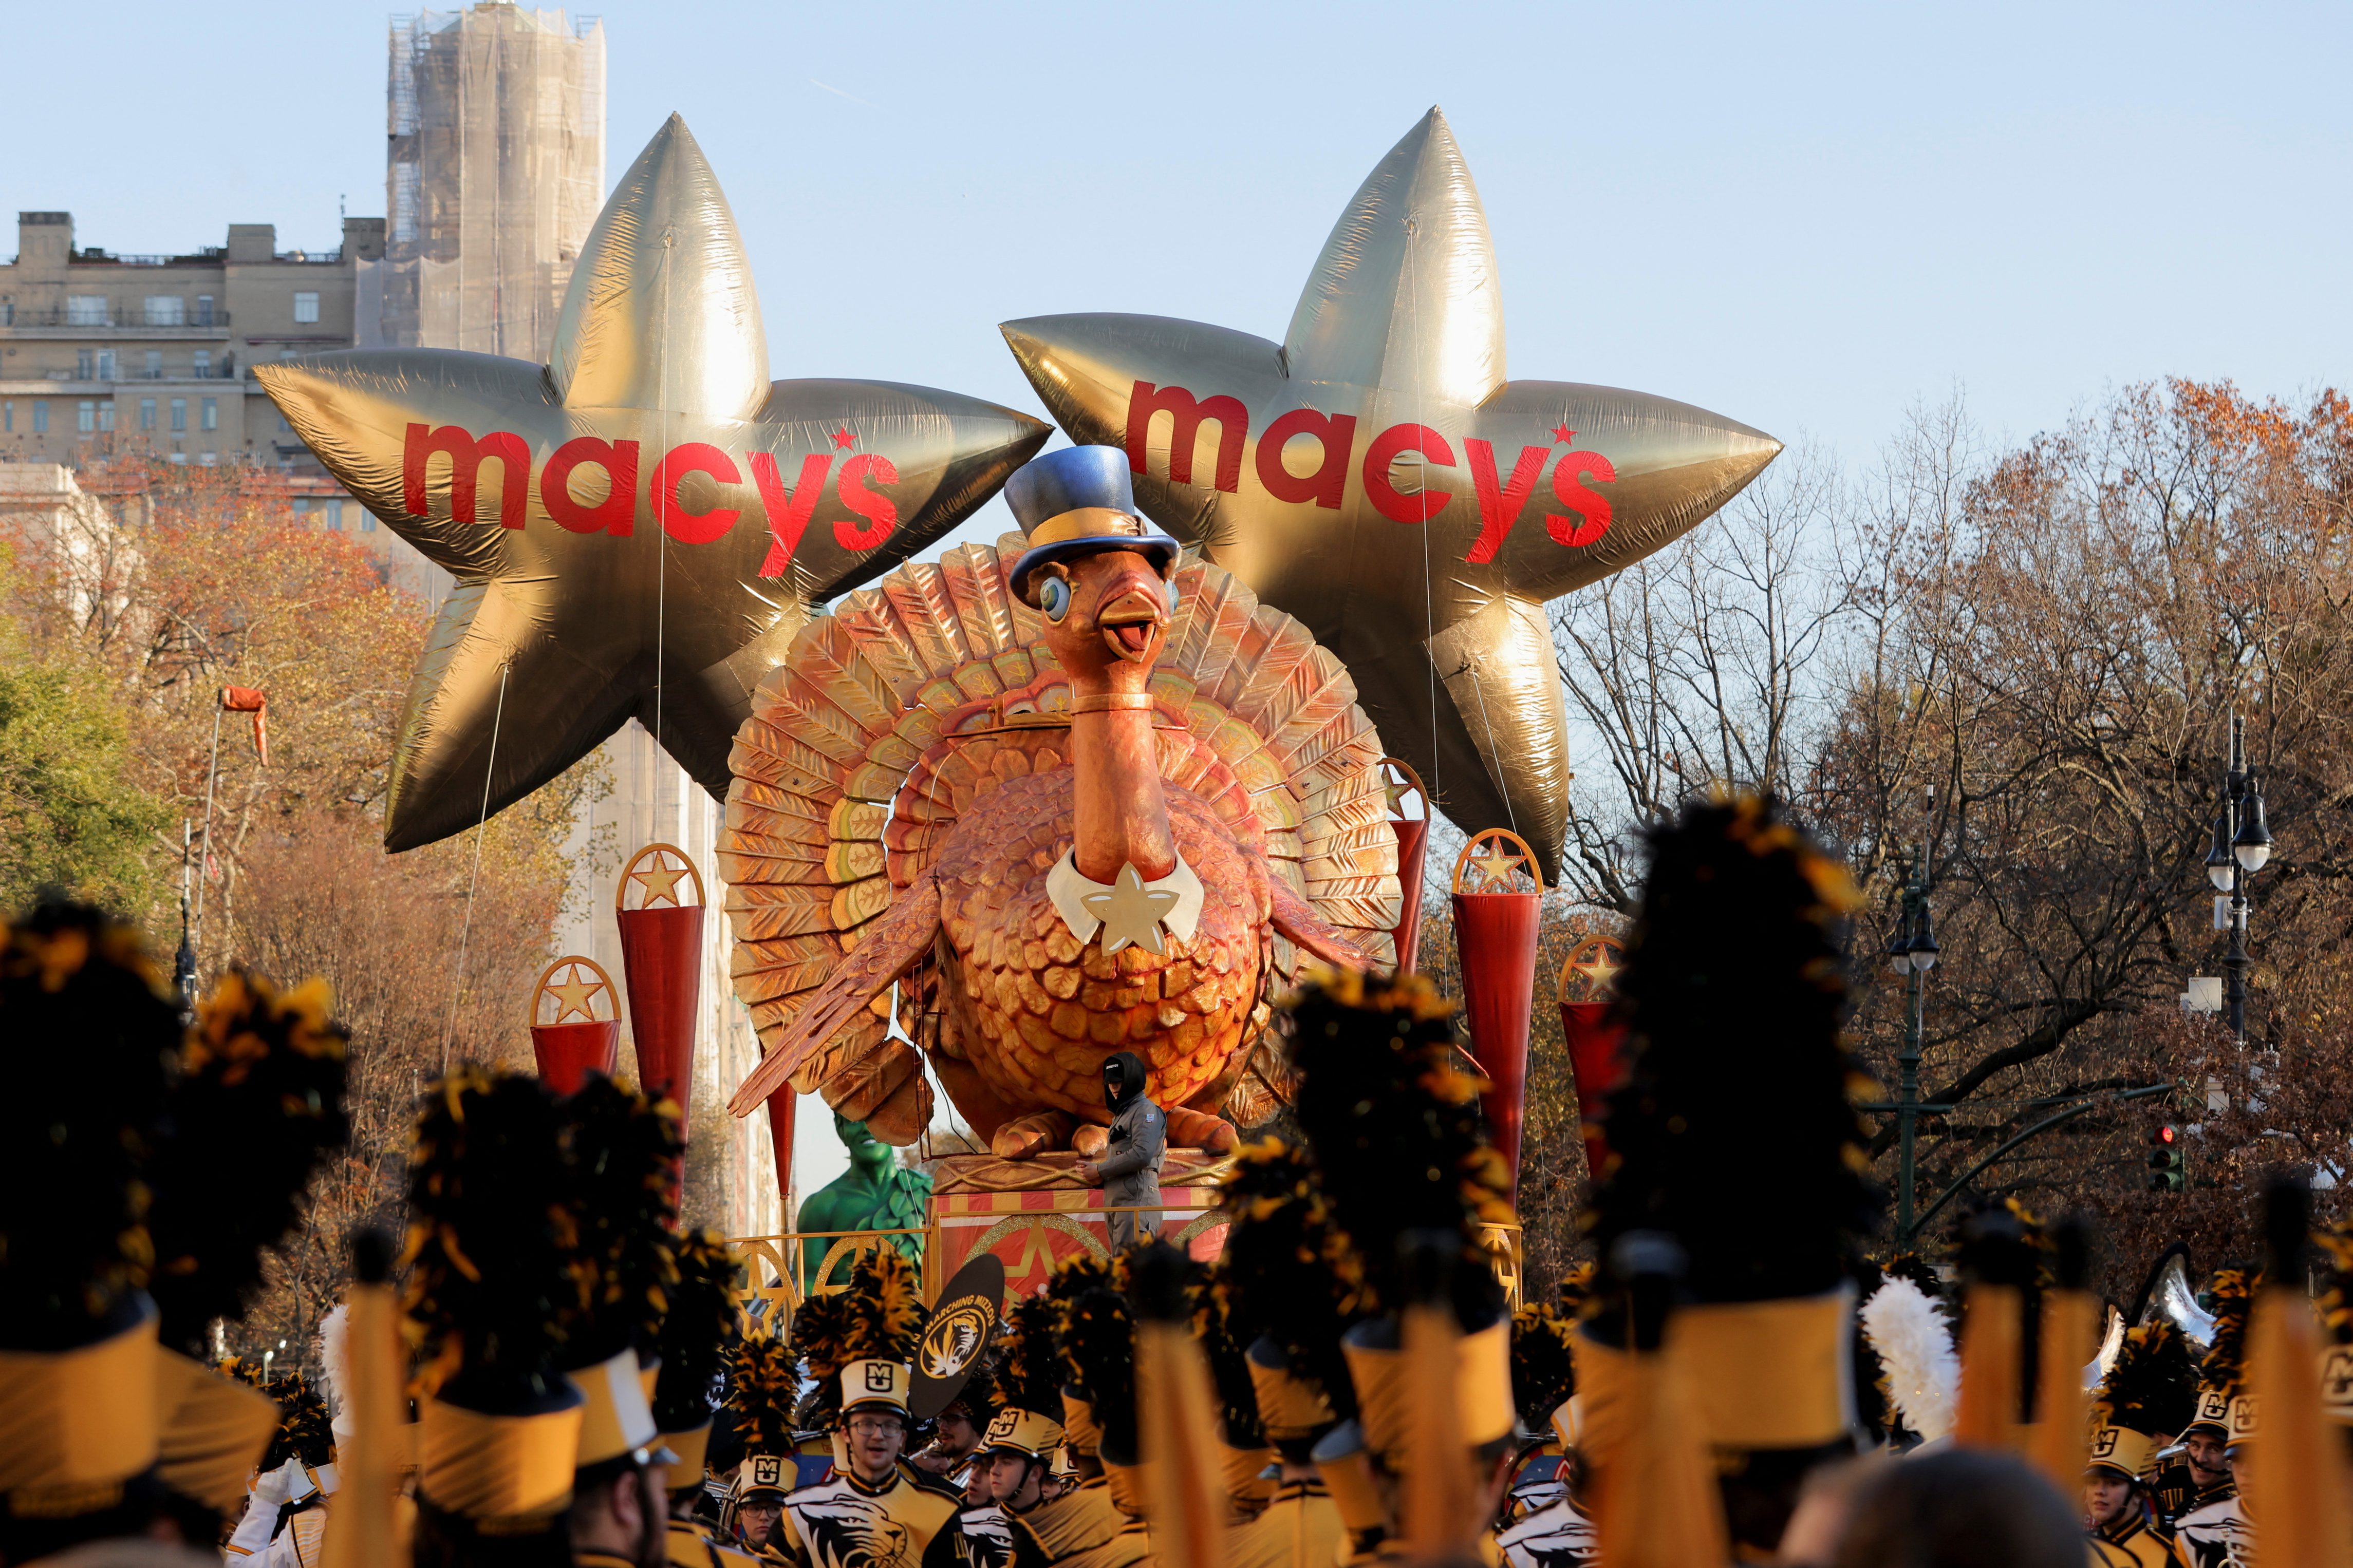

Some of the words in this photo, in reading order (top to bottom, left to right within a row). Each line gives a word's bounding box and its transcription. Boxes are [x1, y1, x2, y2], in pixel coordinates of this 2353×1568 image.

[925, 1294, 975, 1334] MARCHING
[974, 1294, 996, 1327] MIZZOU
[867, 1364, 892, 1391] MU
[997, 1412, 1018, 1437] MU
[756, 1460, 779, 1484] MU
